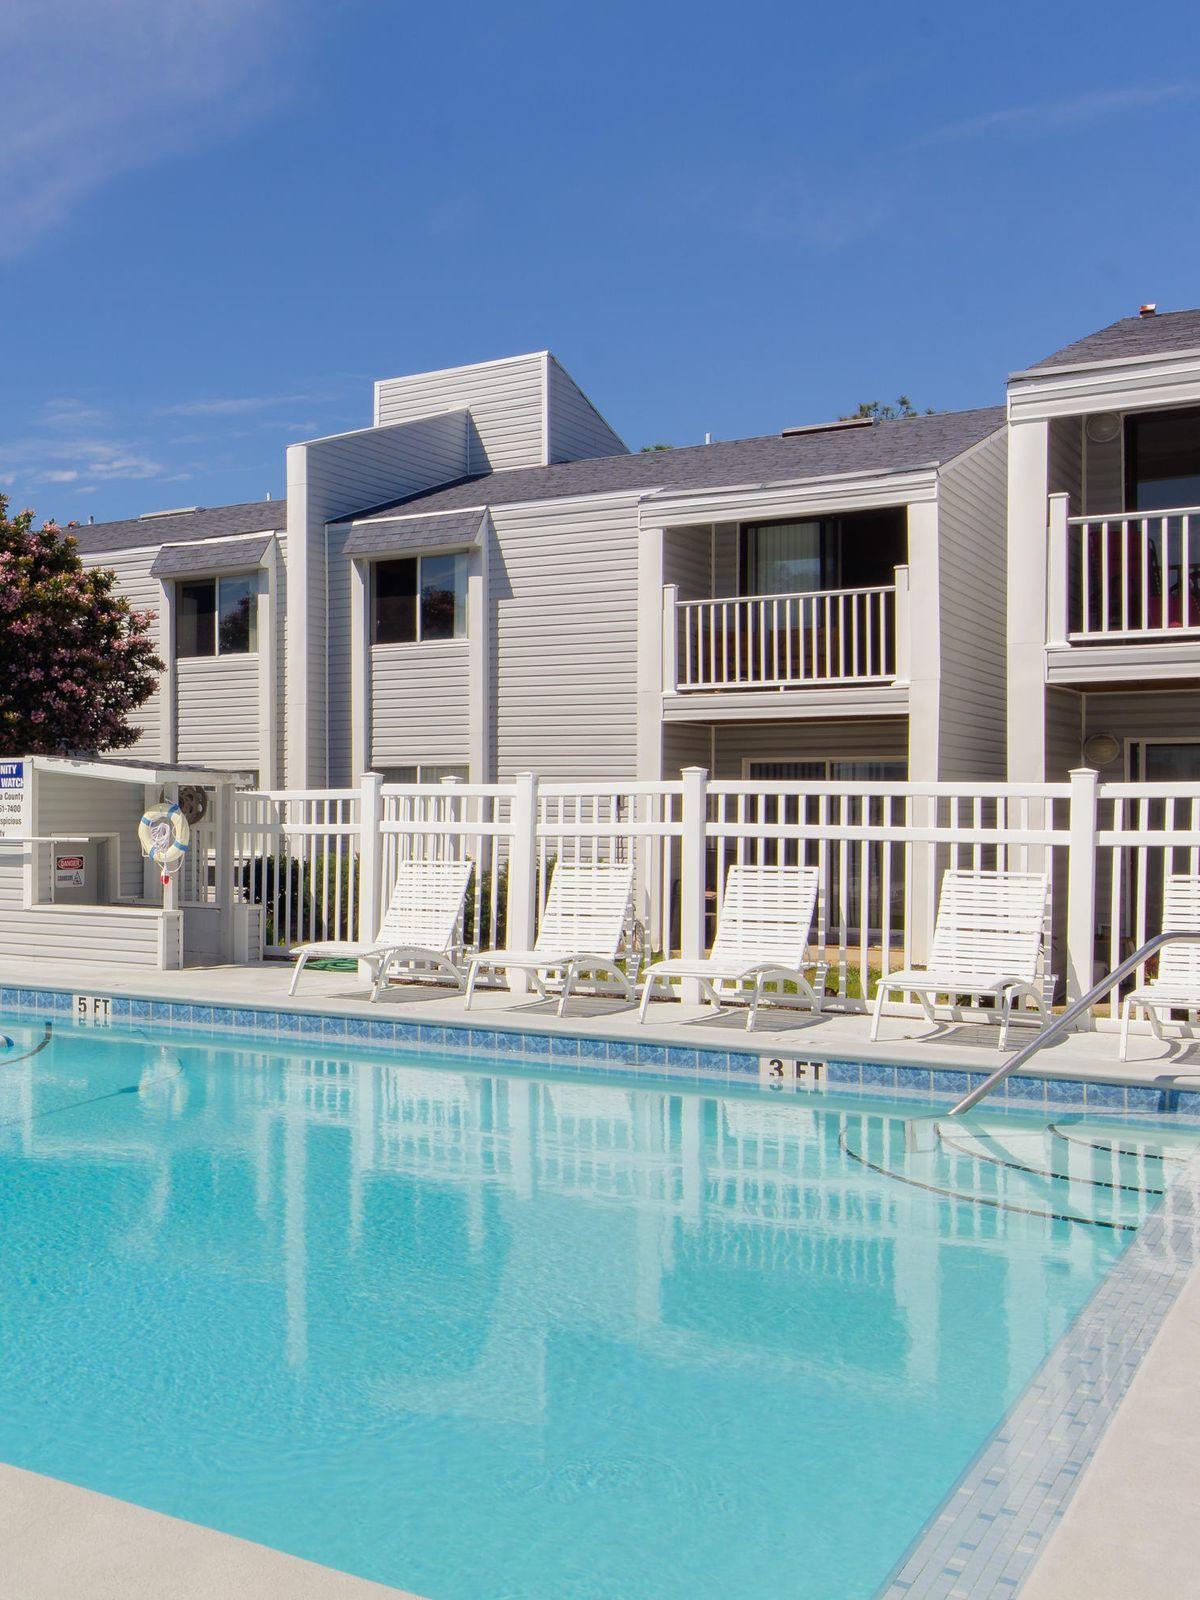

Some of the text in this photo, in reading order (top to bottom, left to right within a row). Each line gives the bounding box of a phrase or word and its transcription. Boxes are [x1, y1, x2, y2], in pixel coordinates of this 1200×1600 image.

[4, 792, 24, 803] County
[78, 997, 87, 1013] 5
[769, 1059, 824, 1080] 3 FT
